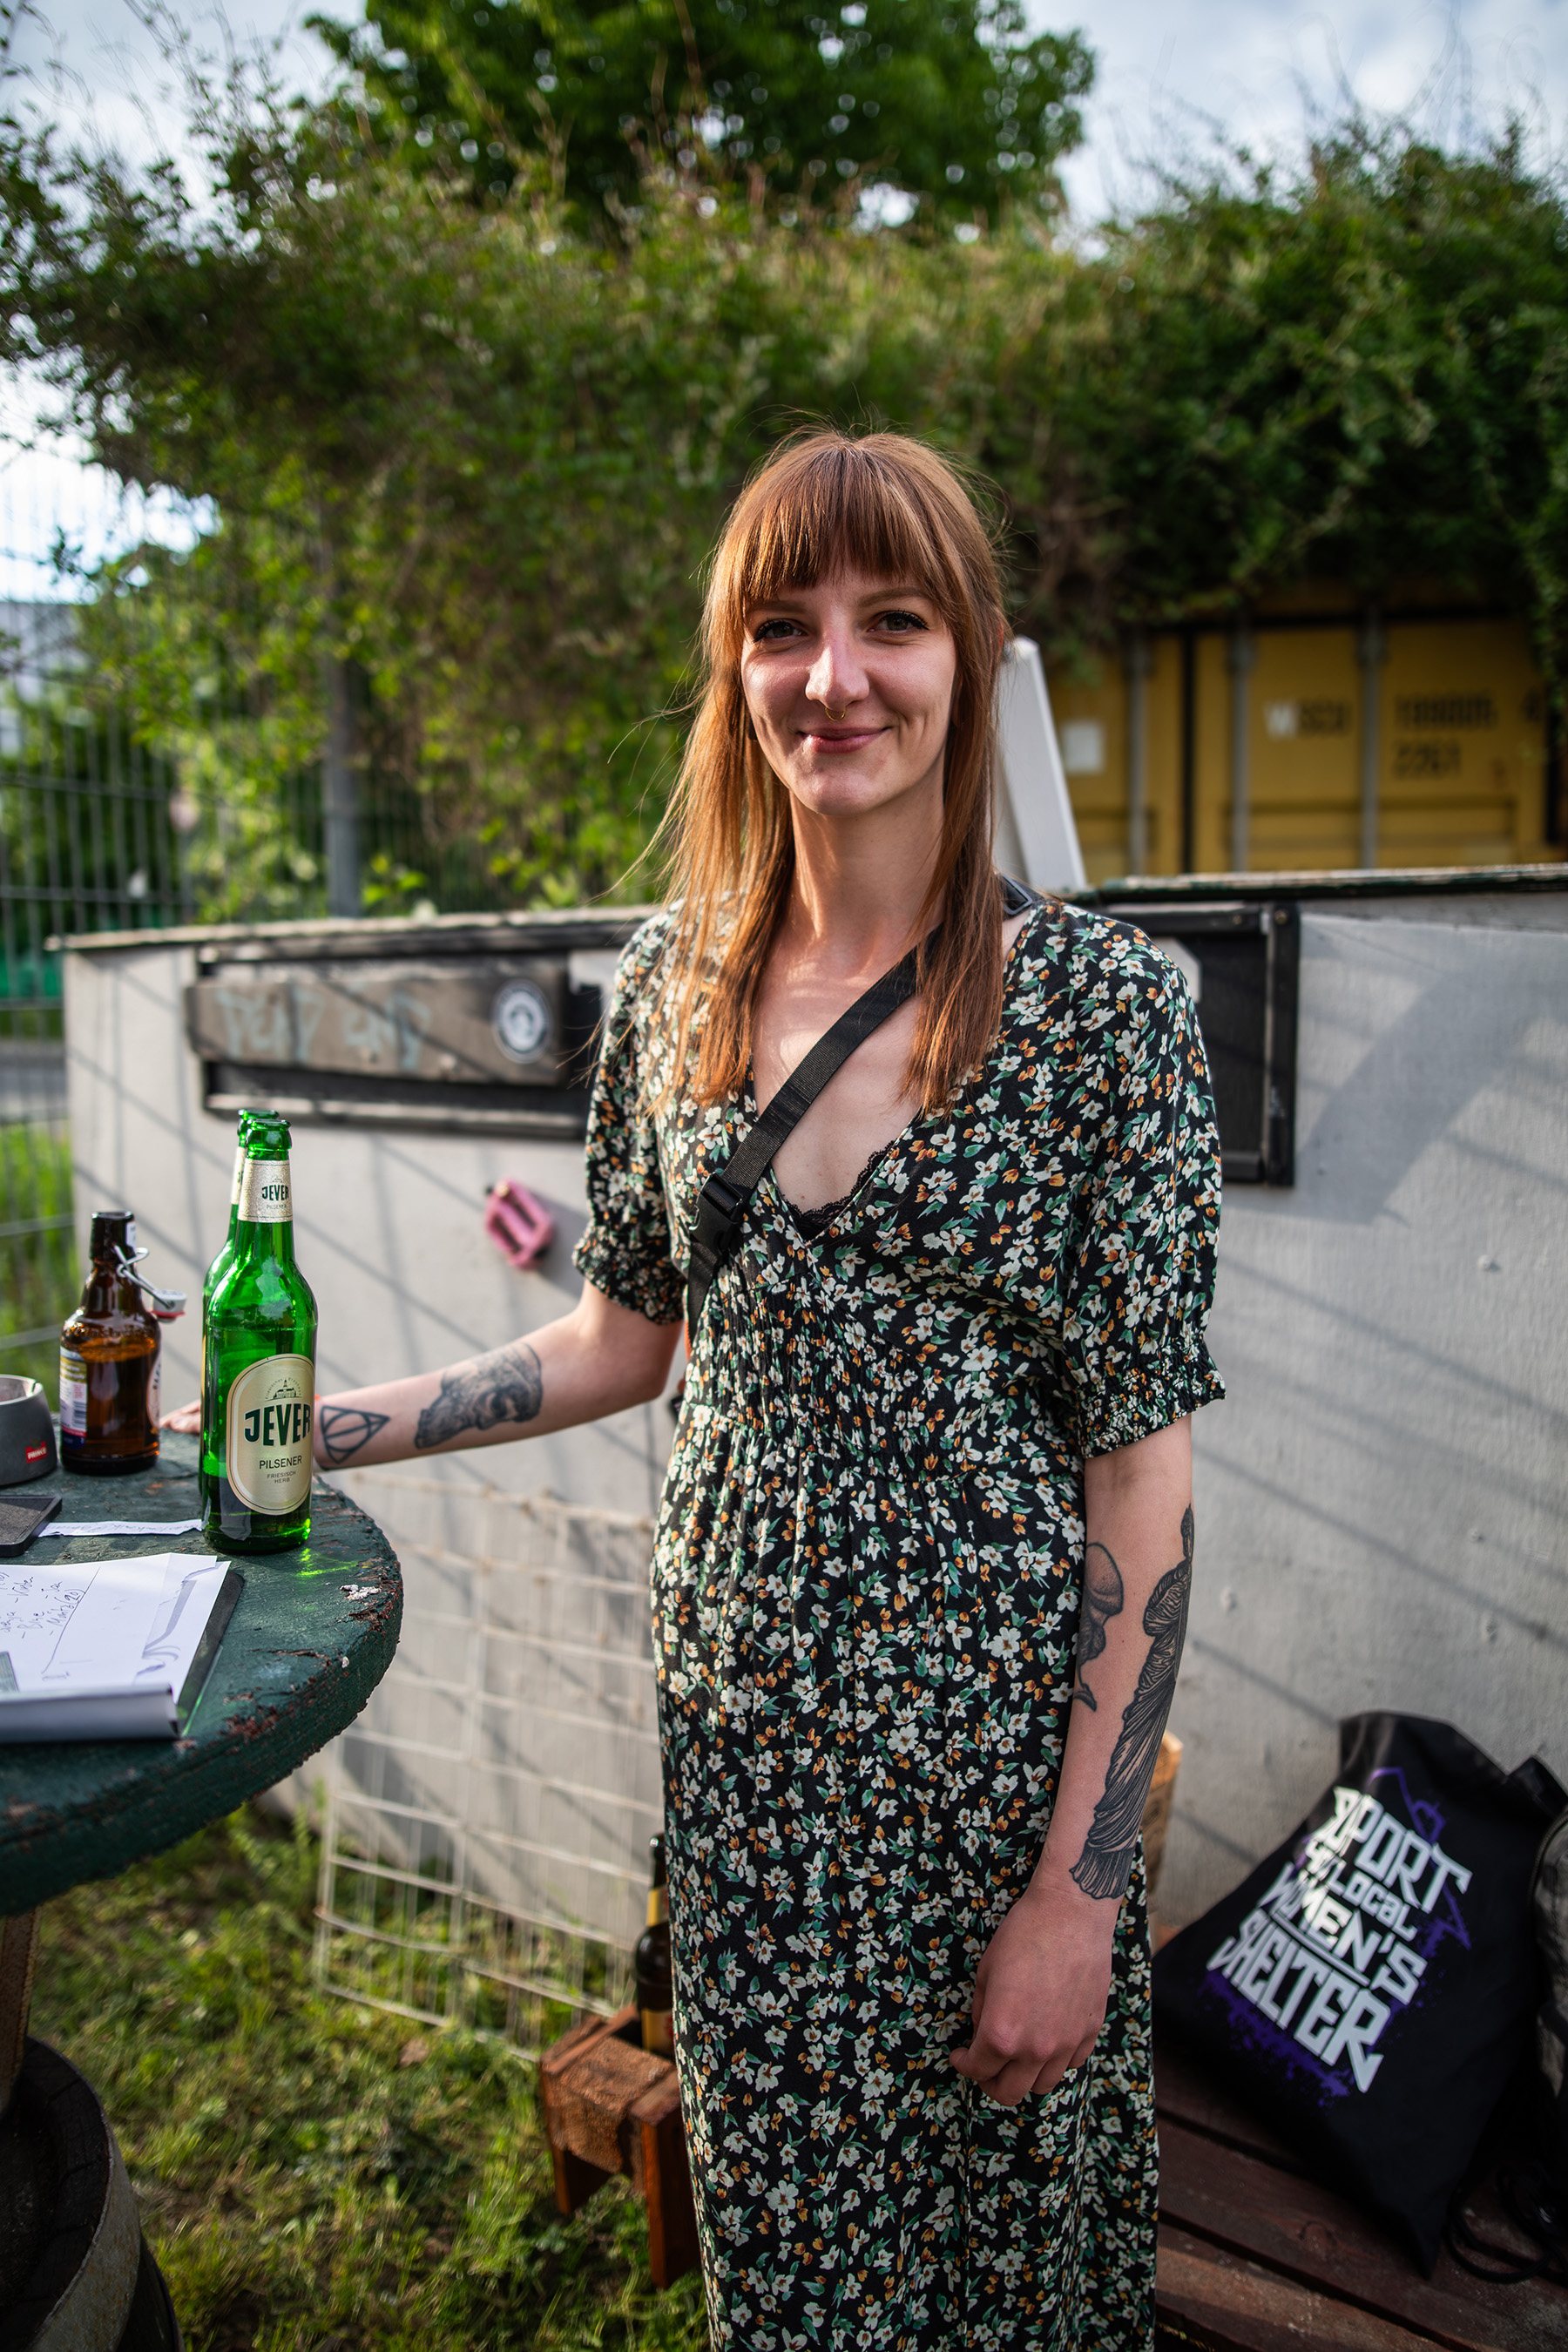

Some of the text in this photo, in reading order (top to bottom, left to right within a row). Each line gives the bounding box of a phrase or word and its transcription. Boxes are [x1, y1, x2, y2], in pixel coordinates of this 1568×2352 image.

[261, 1184, 290, 1201] JEVER
[244, 1403, 311, 1447] JEVER
[259, 1455, 302, 1470] PILSENER
[267, 1470, 297, 1479] FRIESISCH
[1206, 1909, 1392, 2094] SHELTER
